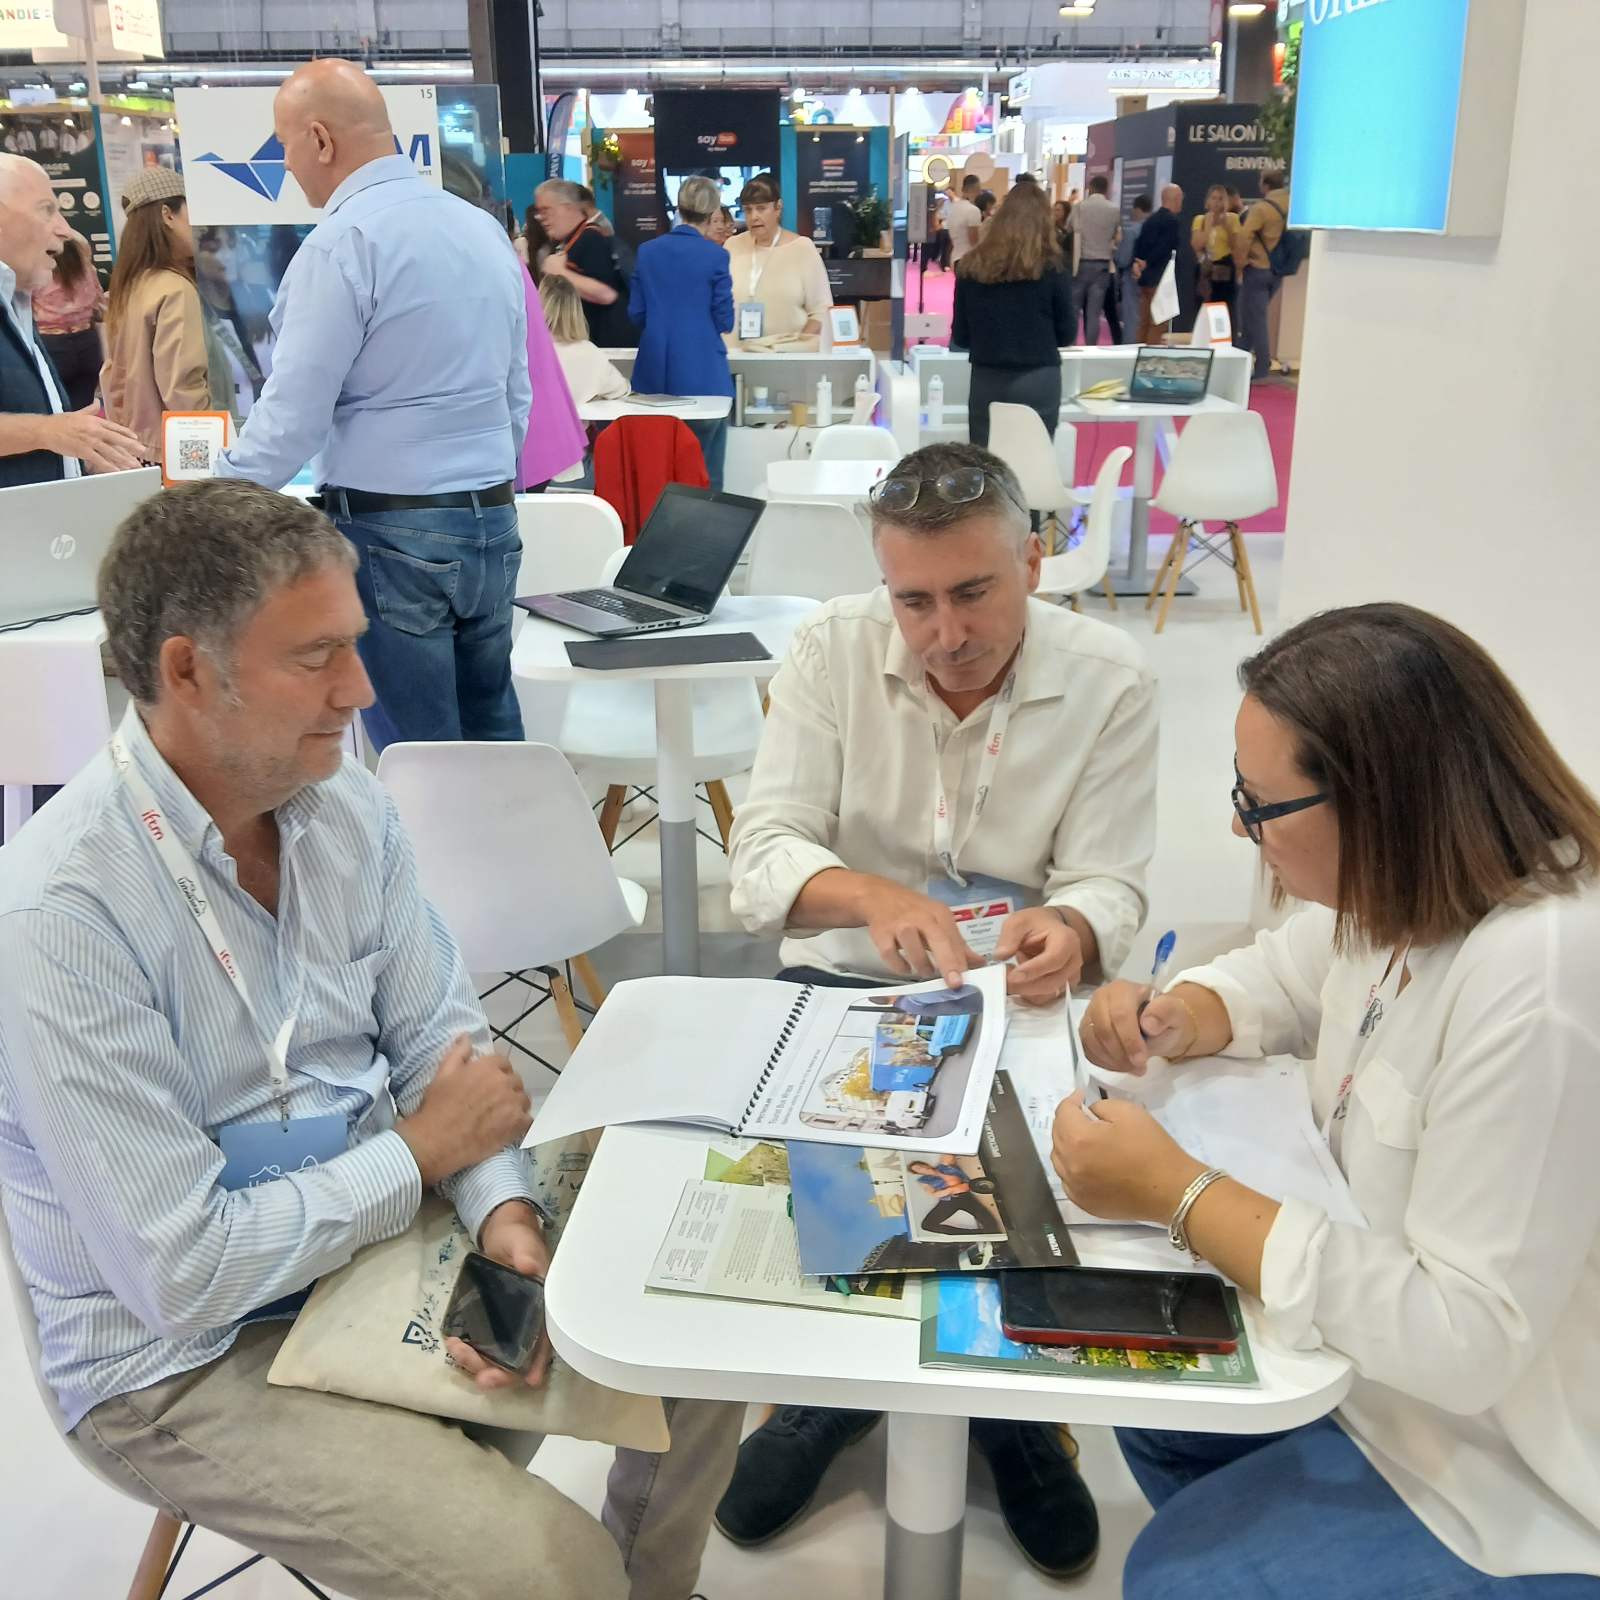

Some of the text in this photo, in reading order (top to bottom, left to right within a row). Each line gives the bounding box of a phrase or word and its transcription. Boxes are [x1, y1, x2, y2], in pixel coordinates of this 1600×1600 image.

[420, 88, 433, 99] 15
[1188, 124, 1205, 141] LE
[1207, 124, 1258, 142] SALON
[51, 534, 76, 560] hp
